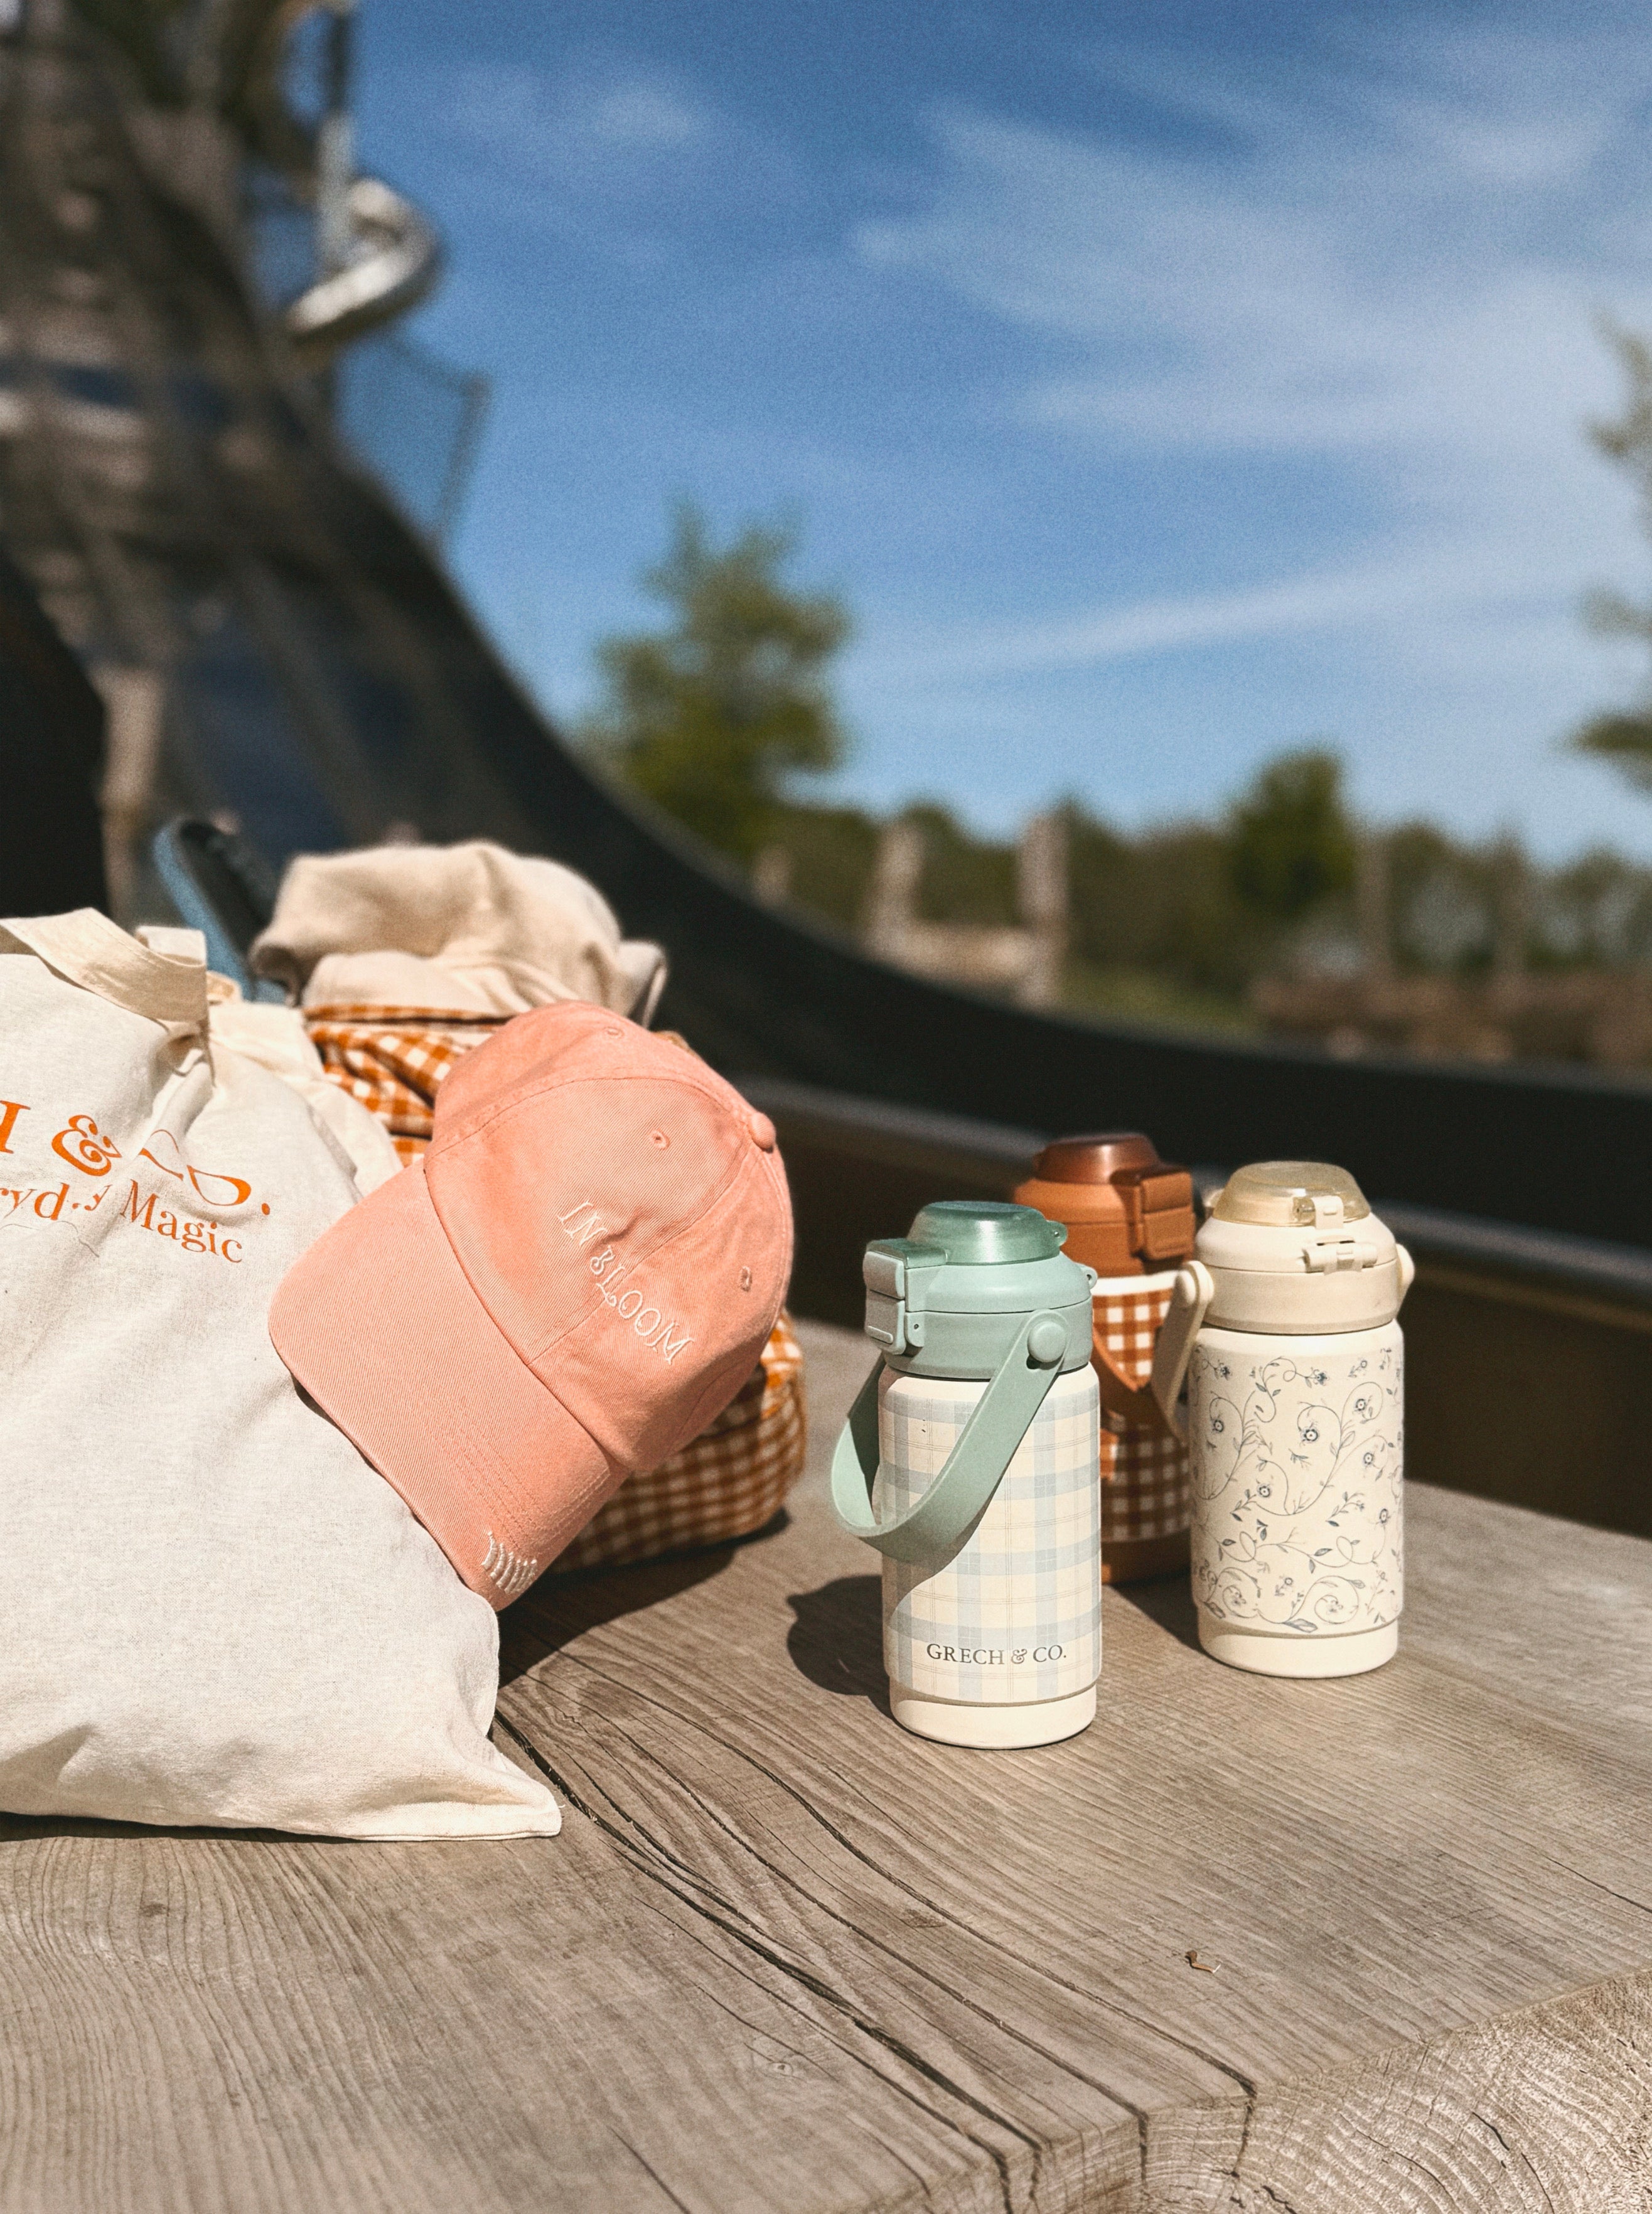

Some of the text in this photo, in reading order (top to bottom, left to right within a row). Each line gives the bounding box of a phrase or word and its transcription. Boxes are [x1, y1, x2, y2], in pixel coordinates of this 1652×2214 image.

[51, 1114, 122, 1176] &
[119, 1179, 243, 1264] Magic
[557, 1200, 695, 1365] IN BLOOM
[926, 1643, 1067, 1665] GRECH & CO.
